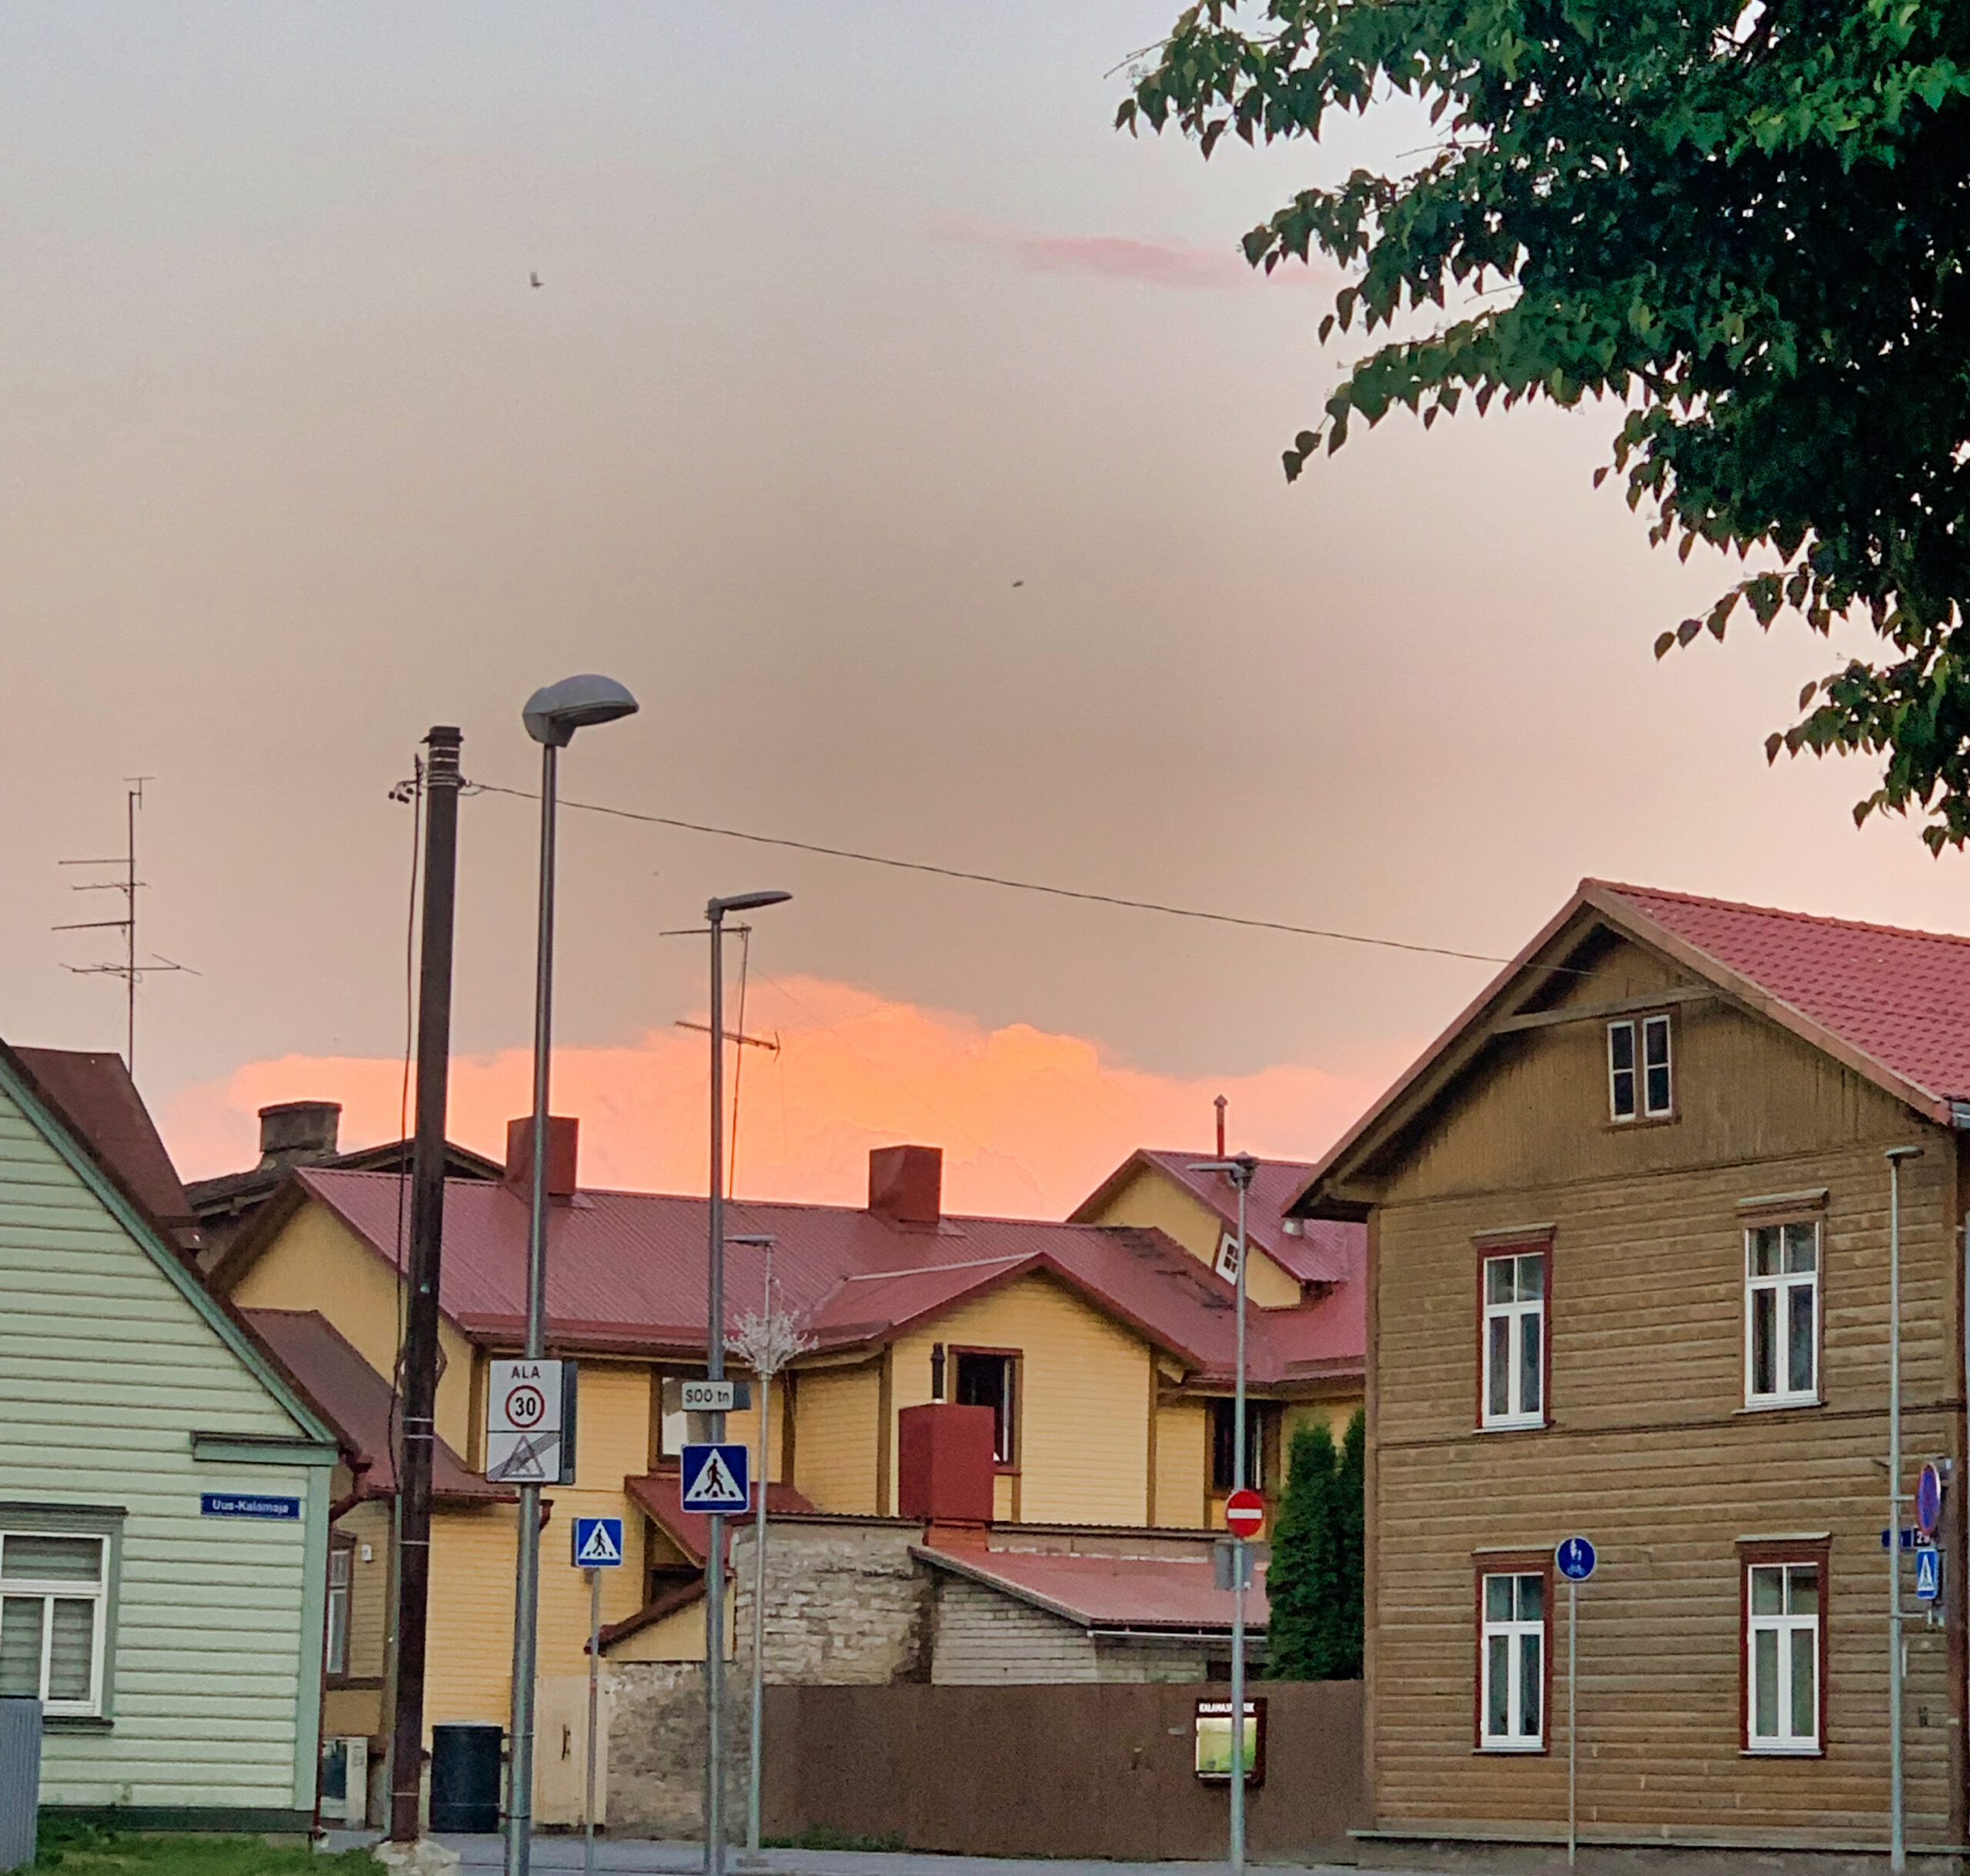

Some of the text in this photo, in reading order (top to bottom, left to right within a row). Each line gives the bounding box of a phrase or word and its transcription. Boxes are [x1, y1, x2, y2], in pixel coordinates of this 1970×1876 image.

[511, 1366, 540, 1379] ALA
[686, 1389, 730, 1403] SOO tn
[515, 1397, 536, 1416] 30
[212, 1499, 289, 1515] Uus-Kalamaja
